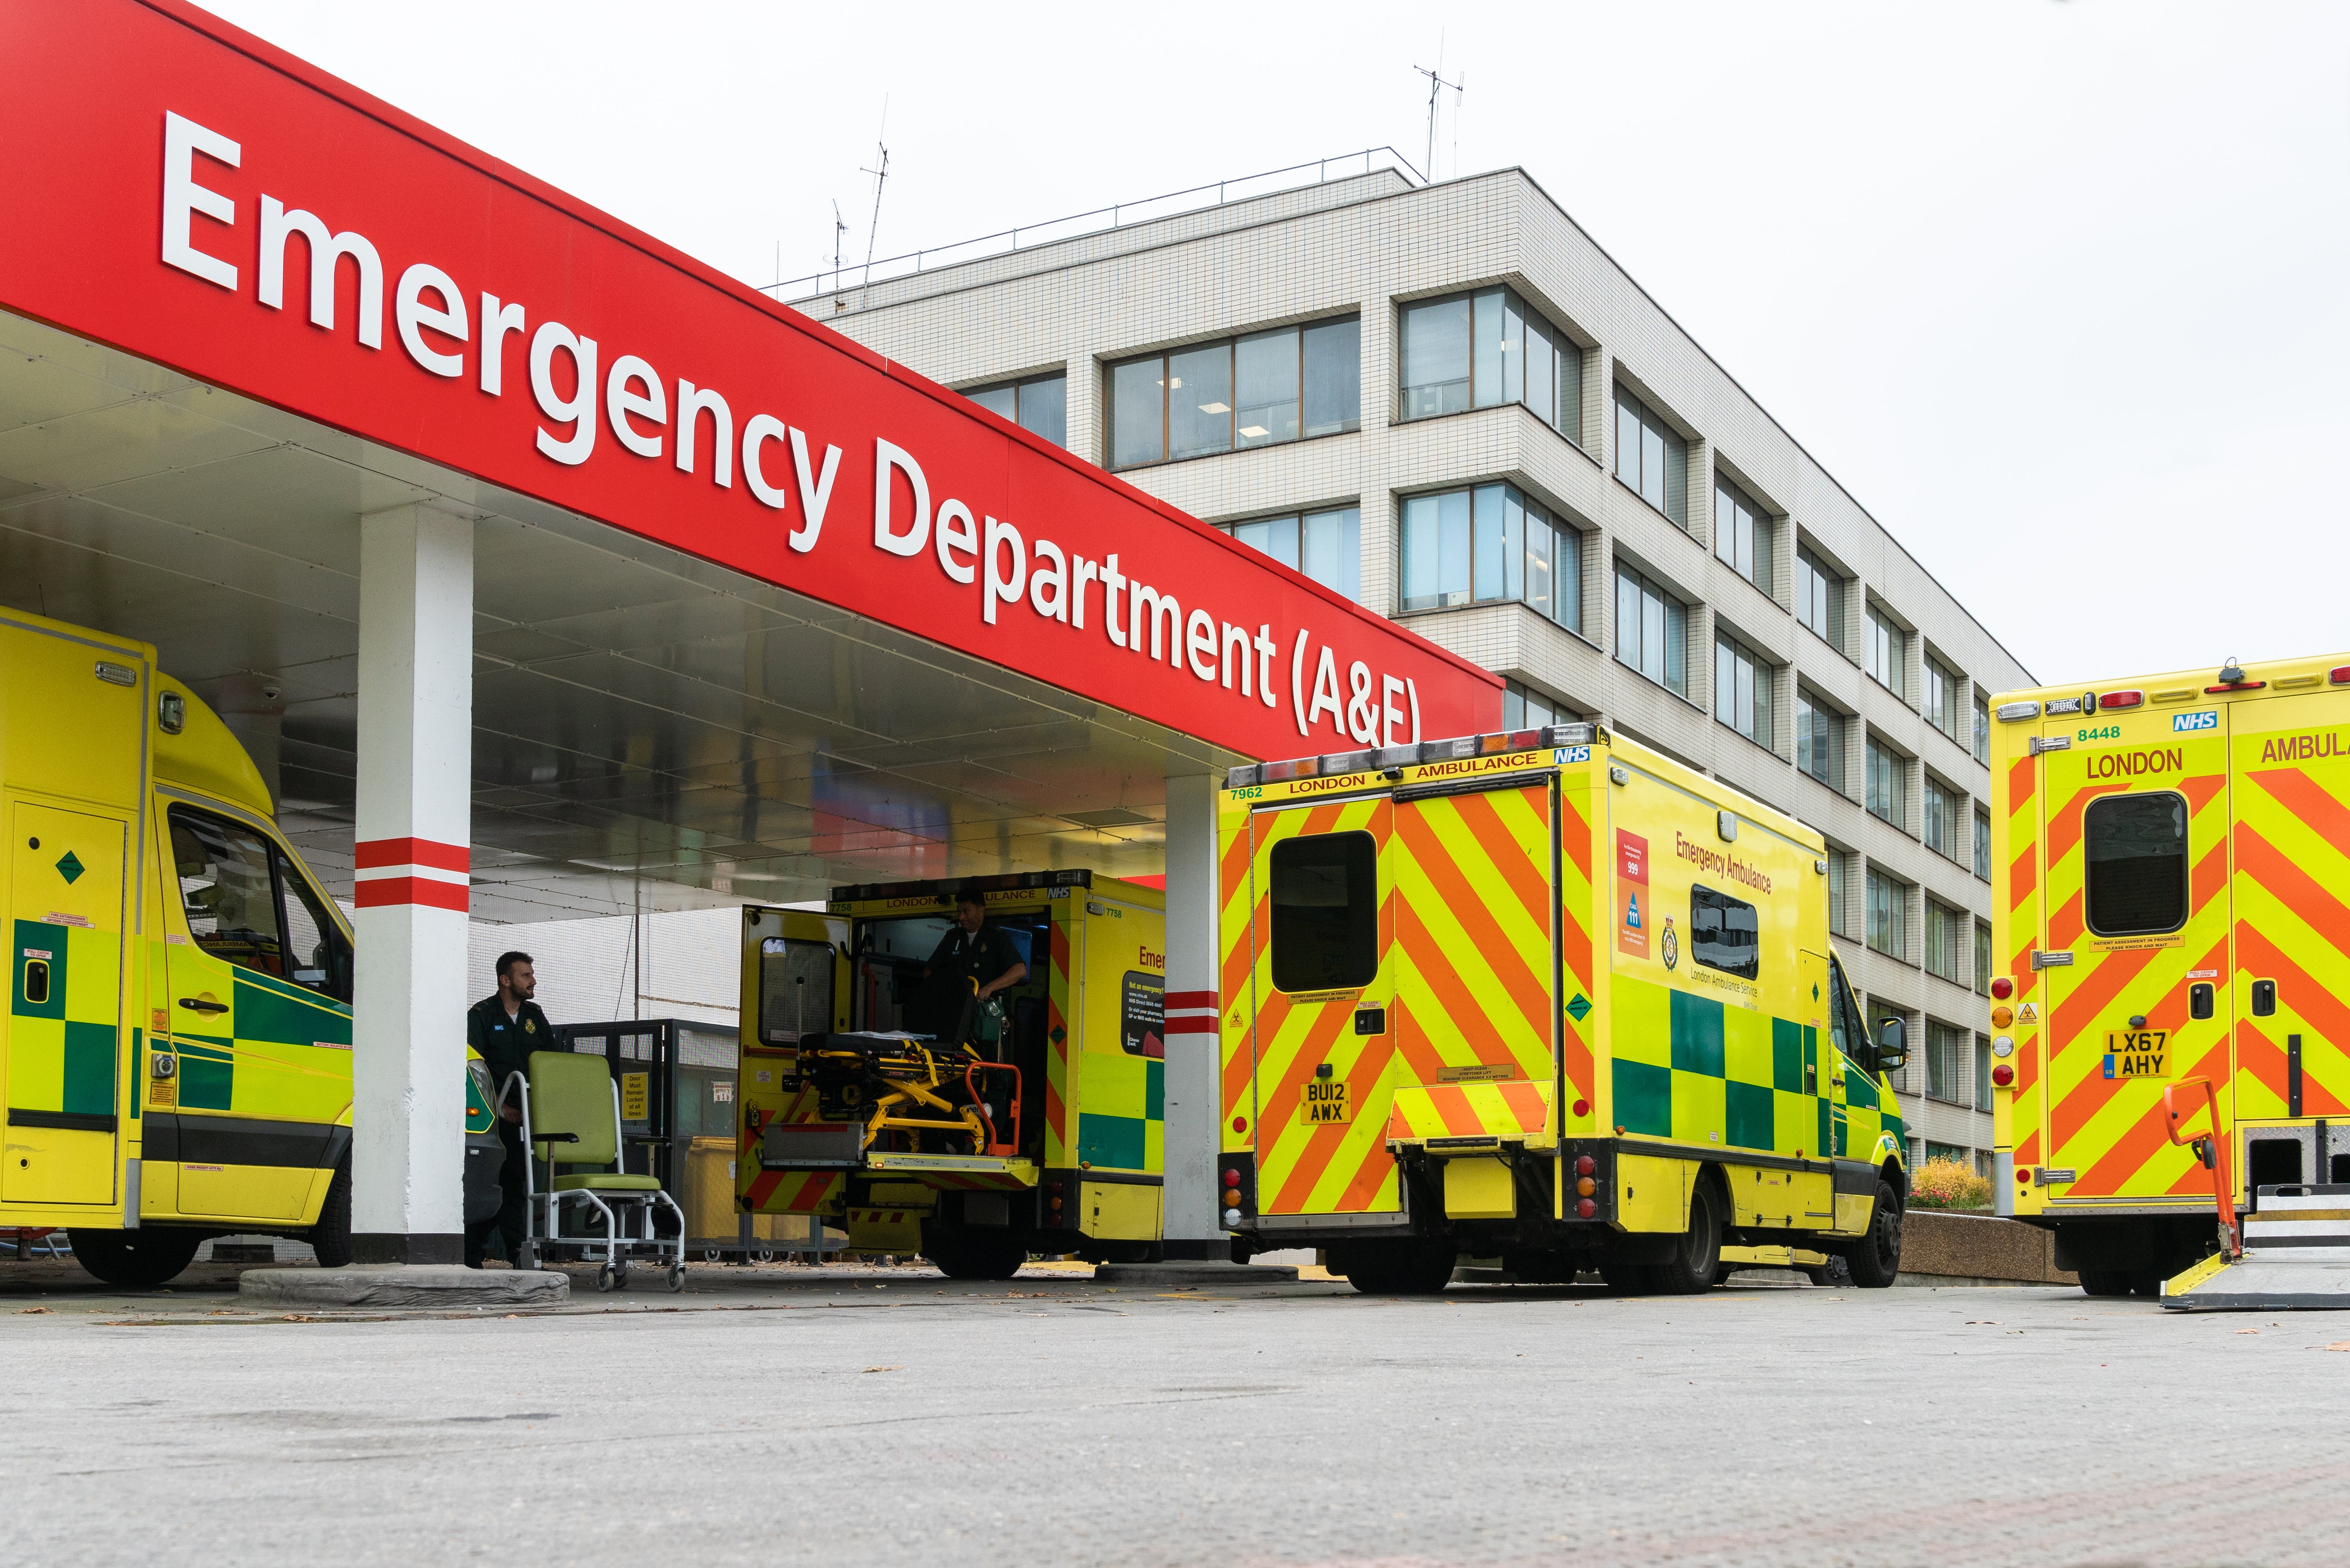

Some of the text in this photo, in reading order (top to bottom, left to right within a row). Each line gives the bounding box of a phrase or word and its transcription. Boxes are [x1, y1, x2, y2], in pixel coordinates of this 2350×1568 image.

[161, 110, 1420, 748] Emergency Department (A&E)
[2174, 712, 2215, 731] NHS
[2078, 726, 2120, 741] 8448
[1555, 746, 1588, 764] NHS
[2087, 733, 2350, 779] LONDON AMBUL
[1290, 753, 1537, 794] LONDON AMBULANCE
[1230, 787, 1262, 800] 7962
[1628, 861, 1638, 875] 999
[1677, 830, 1771, 895] Emergency Ambulance
[887, 890, 1035, 908] LONDON ULANCE
[1048, 888, 1070, 899] NHS
[831, 903, 852, 912] 7758
[1106, 908, 1122, 918] 7758
[1629, 910, 1638, 925] 111
[1142, 985, 1164, 995] emergency?
[1691, 966, 1757, 997] London Ambulance Service
[2109, 1032, 2166, 1052] LX67
[2122, 1055, 2164, 1074] AHY
[1308, 1084, 1344, 1101] BU12
[1311, 1103, 1342, 1121] AWX
